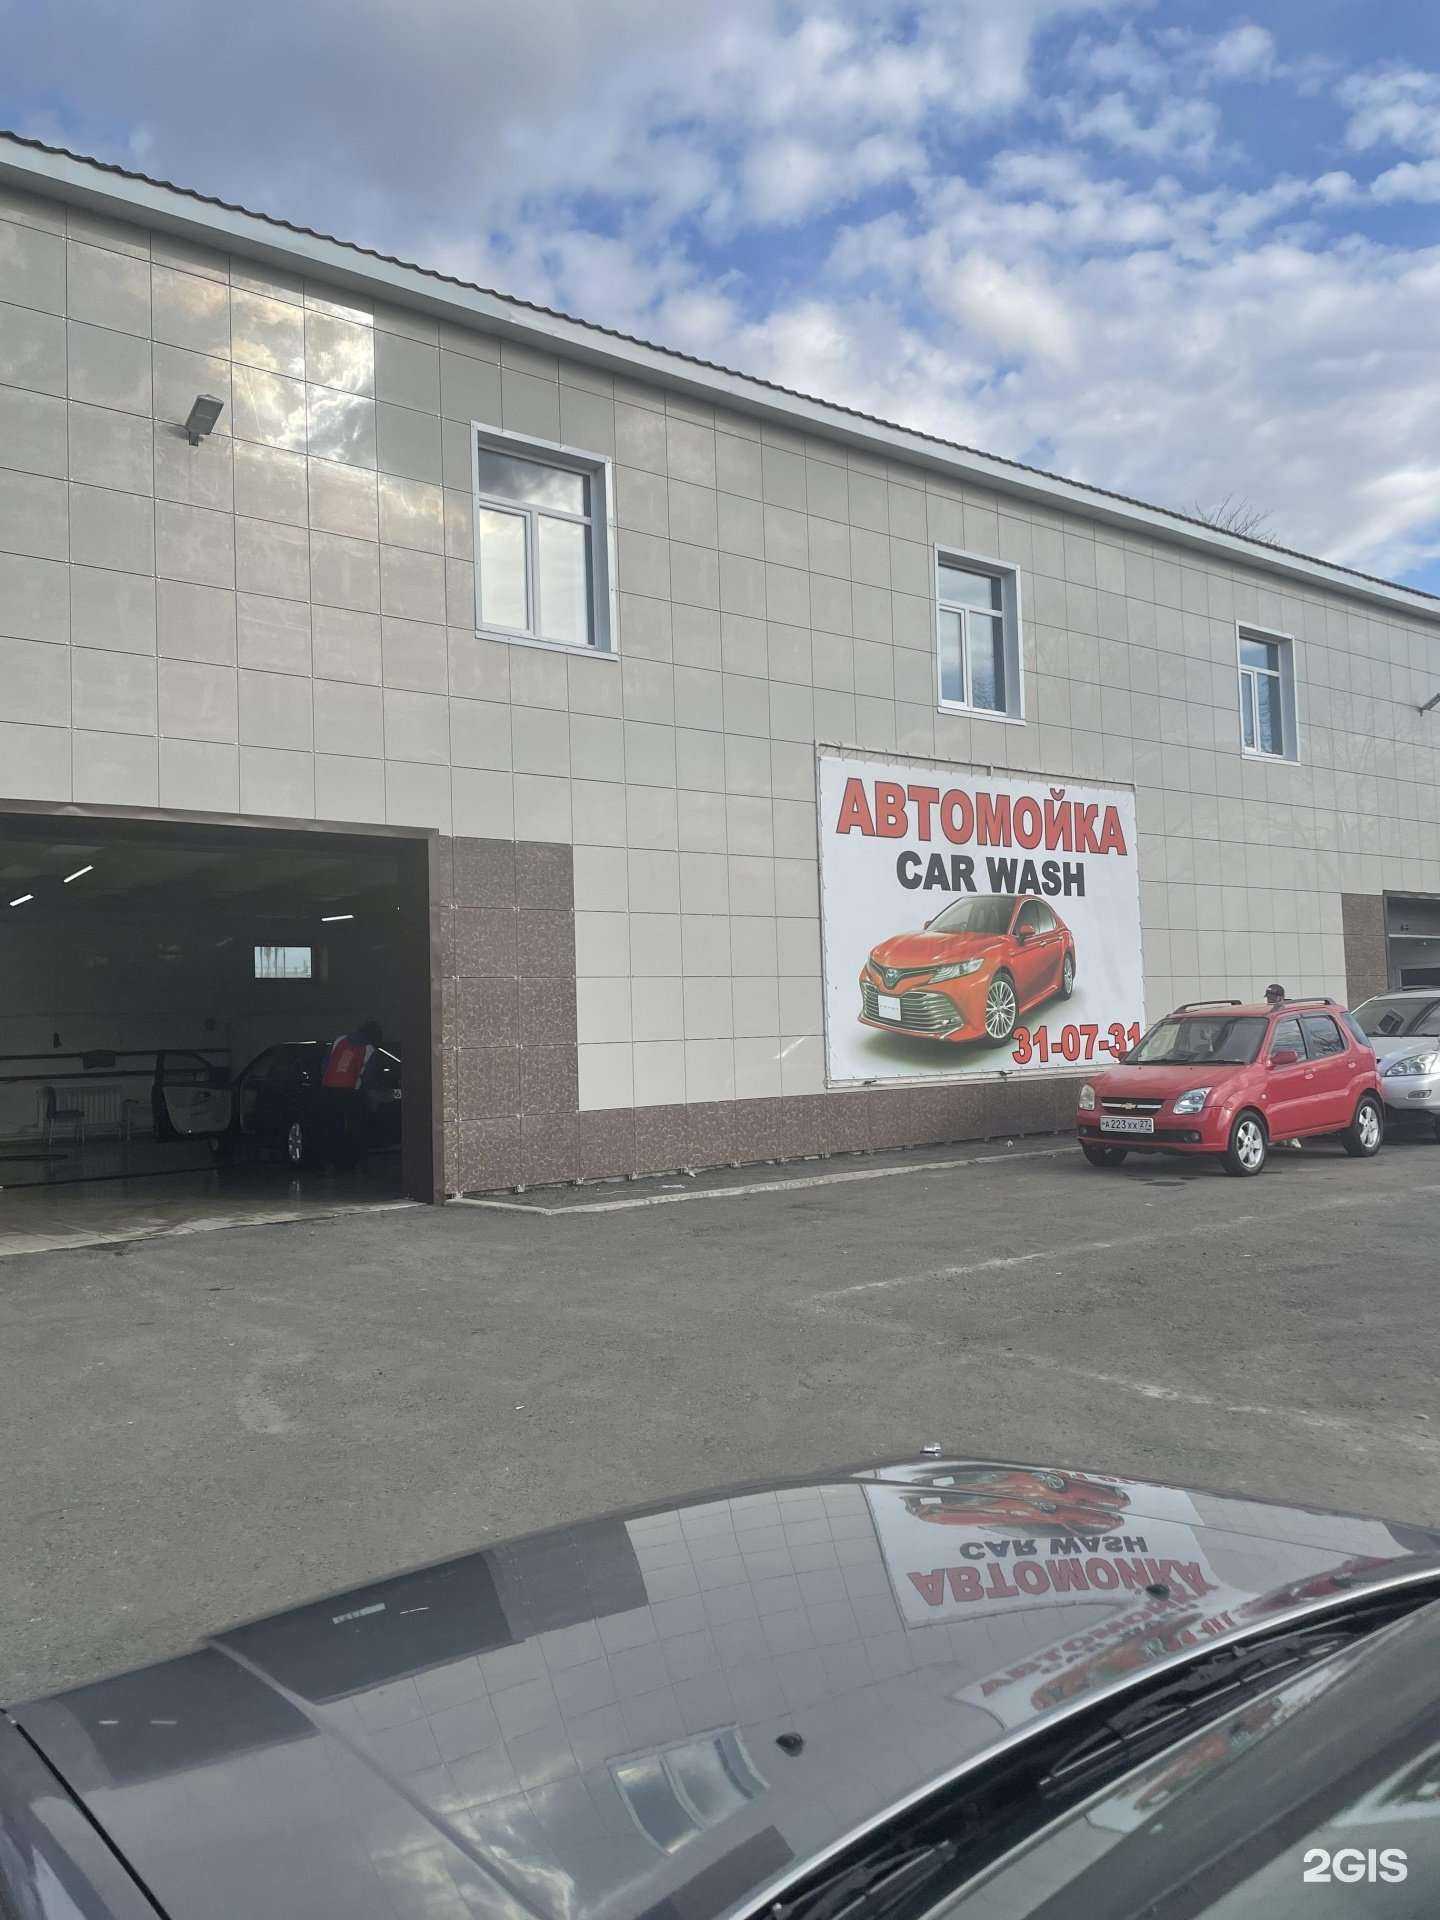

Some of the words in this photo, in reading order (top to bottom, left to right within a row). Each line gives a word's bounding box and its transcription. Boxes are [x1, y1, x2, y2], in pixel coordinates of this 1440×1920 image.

[835, 777, 1128, 856] АВТОМОЙКА
[896, 850, 977, 893] CAR
[986, 856, 1086, 897] WASH
[1012, 1022, 1141, 1065] 31-07-31
